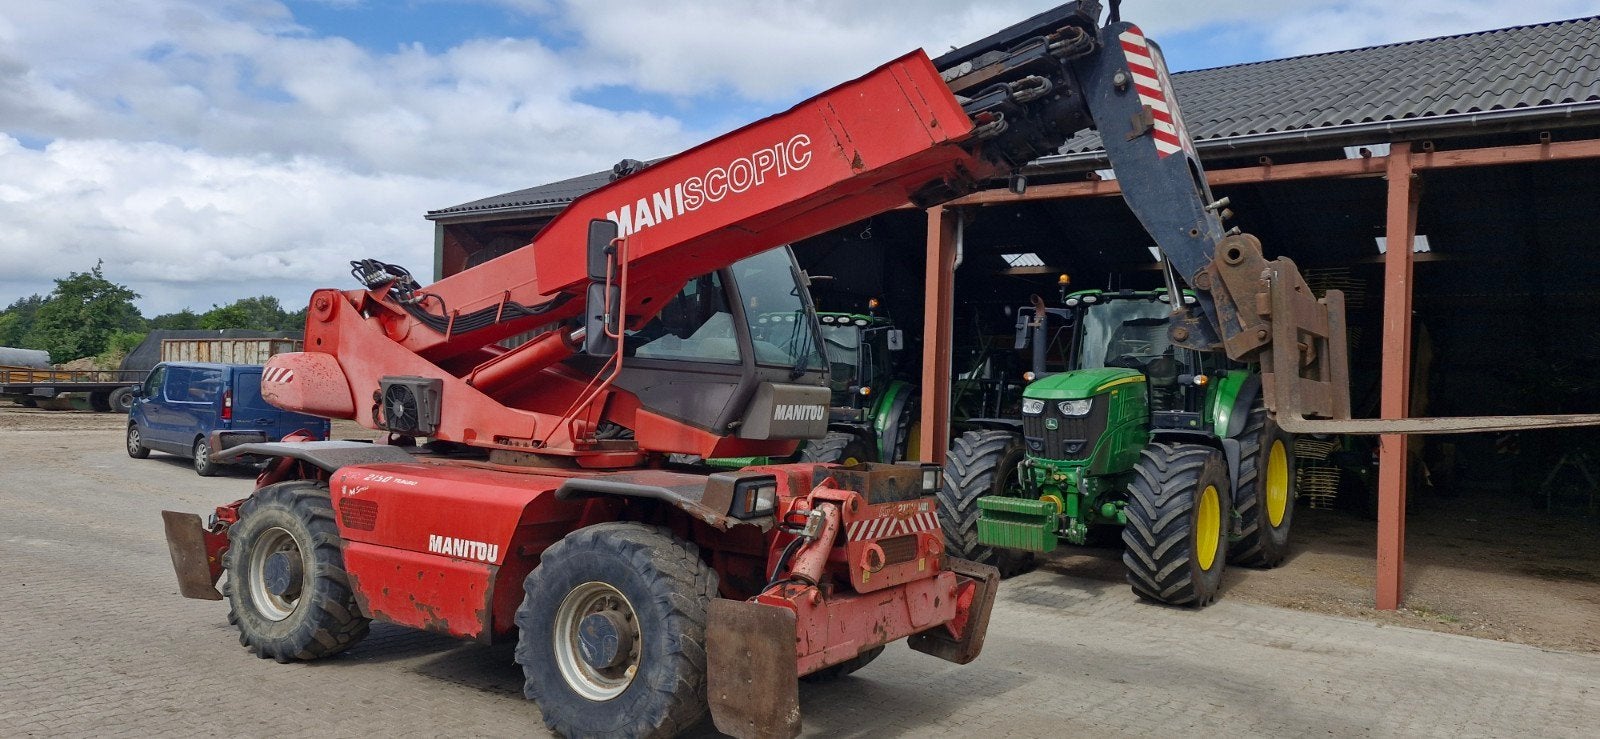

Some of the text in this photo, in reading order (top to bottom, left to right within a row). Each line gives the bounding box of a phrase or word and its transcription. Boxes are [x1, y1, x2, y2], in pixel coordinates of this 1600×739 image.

[606, 133, 812, 238] MANISCOPIC
[774, 404, 825, 421] MANITOU
[364, 473, 394, 483] 2150
[429, 534, 499, 562] MANITOU
